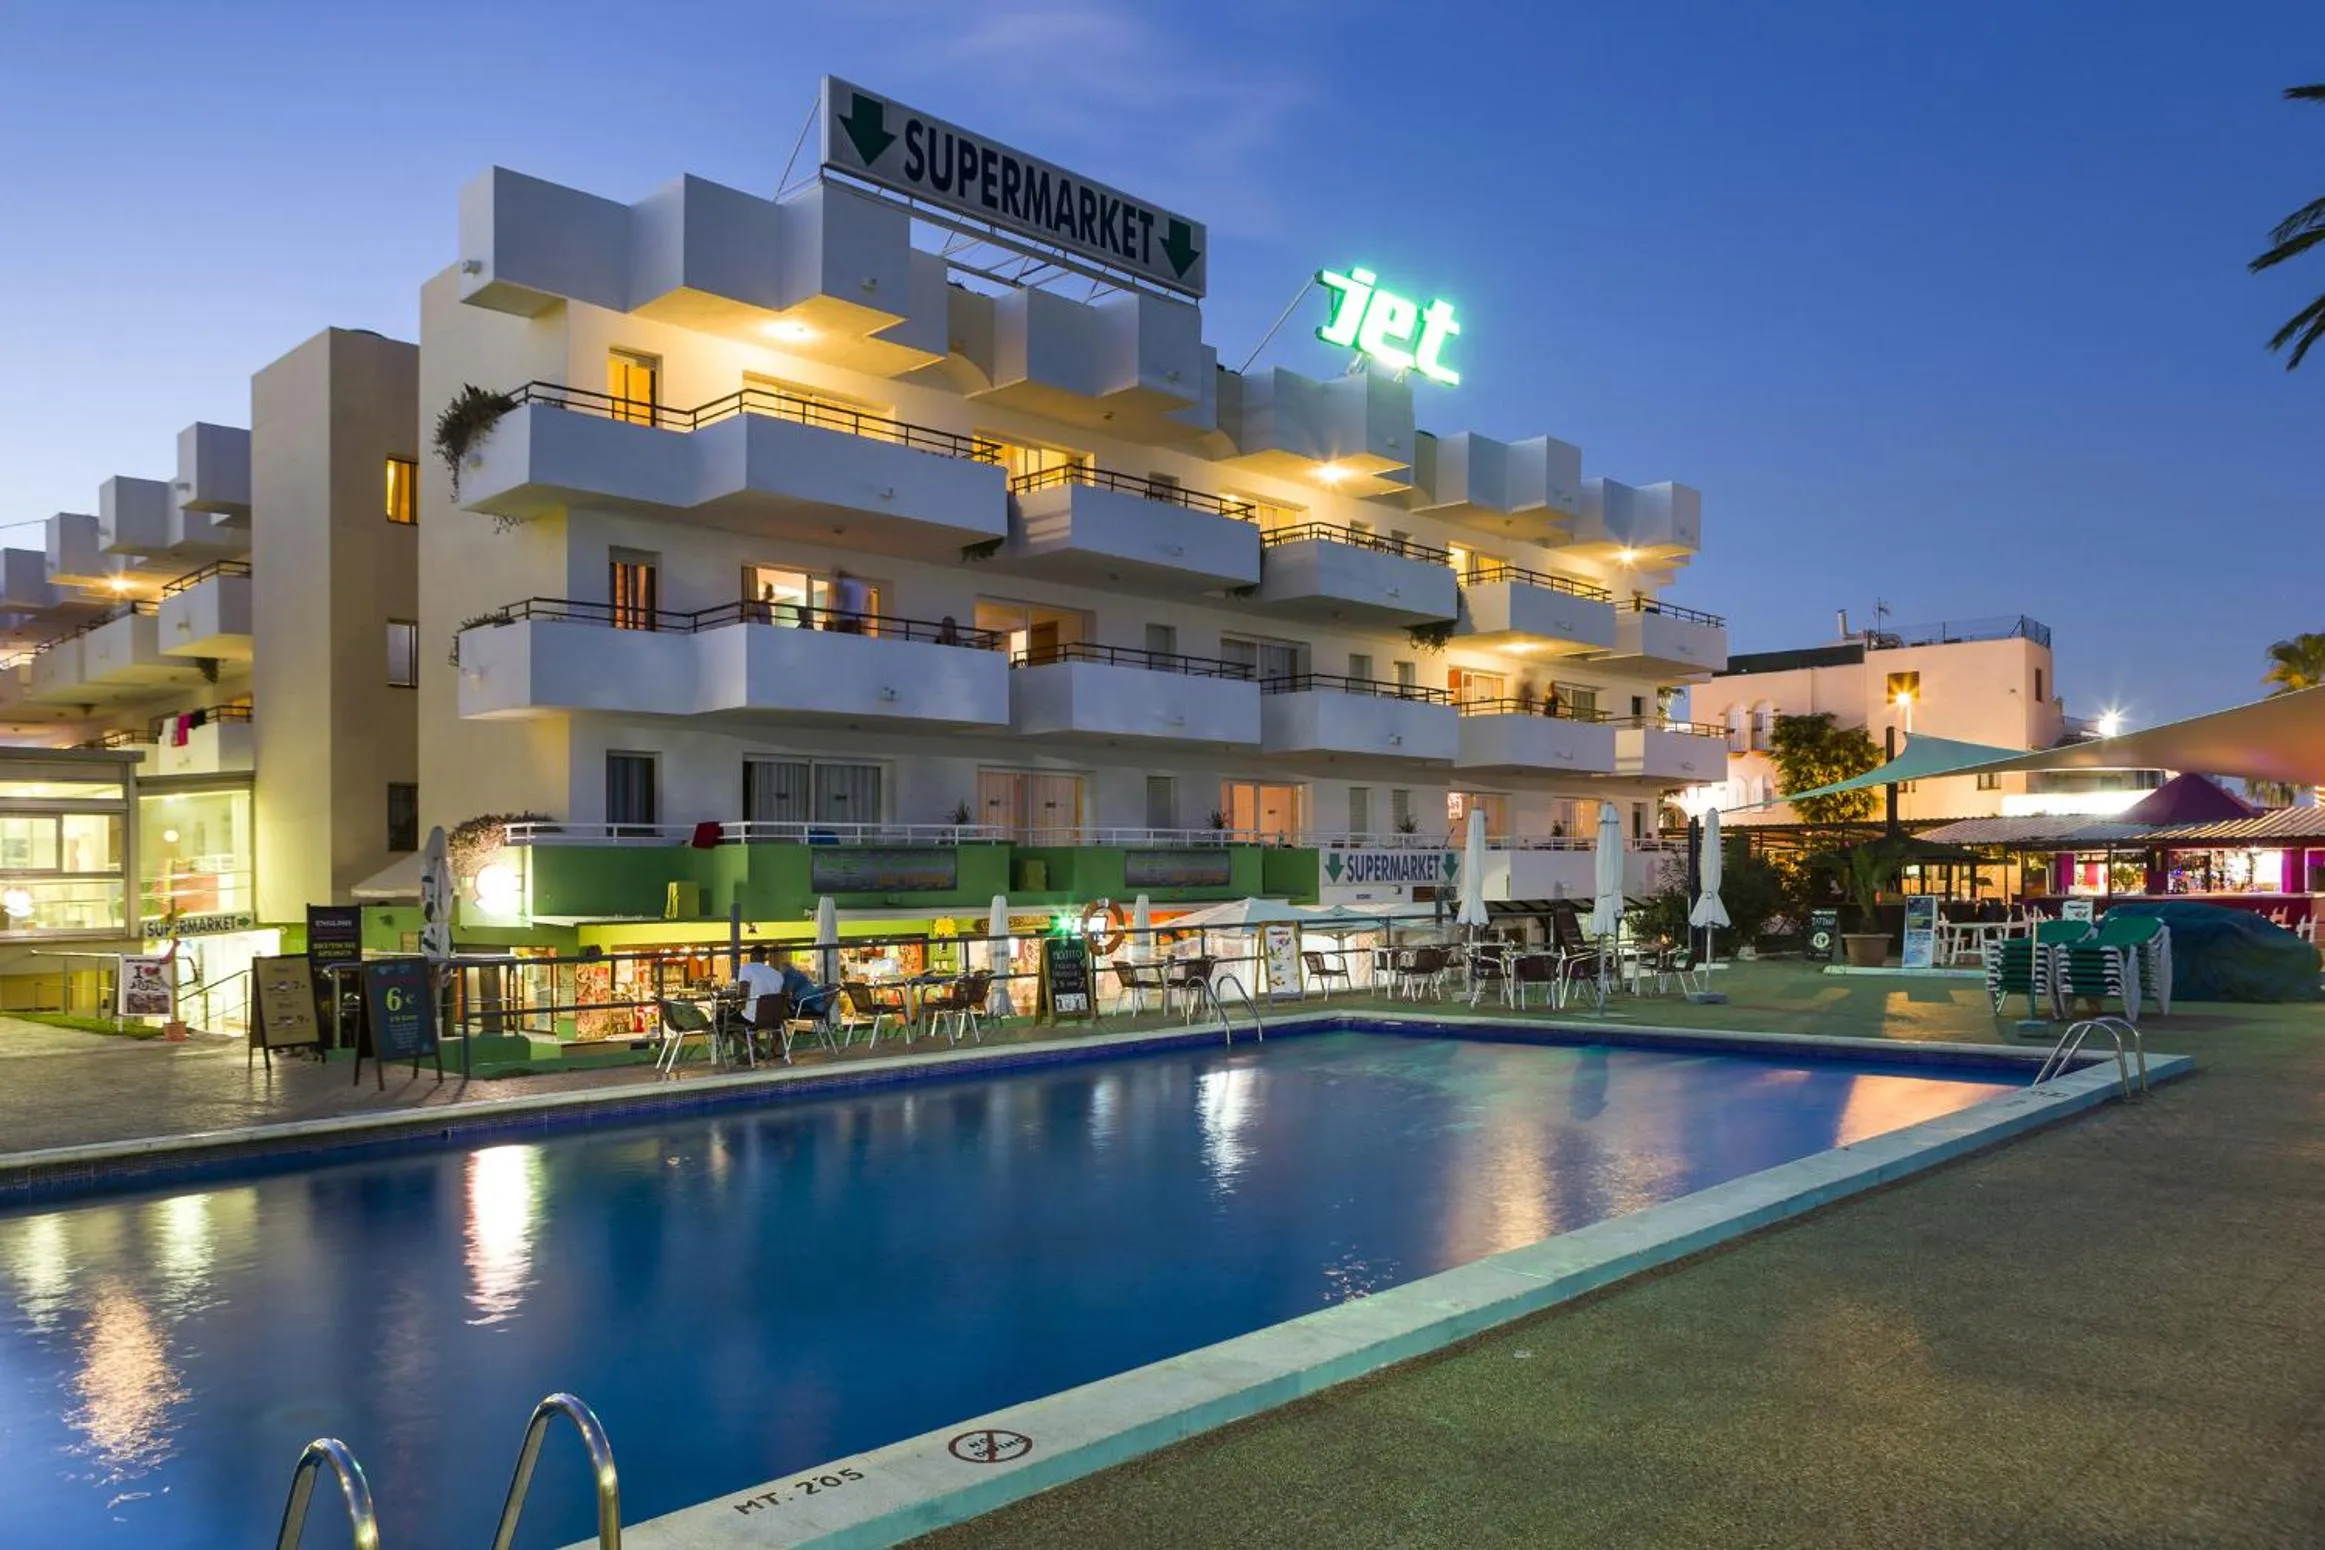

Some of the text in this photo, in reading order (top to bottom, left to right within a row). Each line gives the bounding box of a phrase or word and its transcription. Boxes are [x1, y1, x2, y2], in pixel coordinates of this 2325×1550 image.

[904, 118, 1154, 264] SUPERMARKET
[1316, 266, 1461, 387] jet
[1347, 854, 1440, 882] SUPERMARKET
[147, 915, 236, 937] SUPERMARKET
[386, 986, 402, 1011] 6
